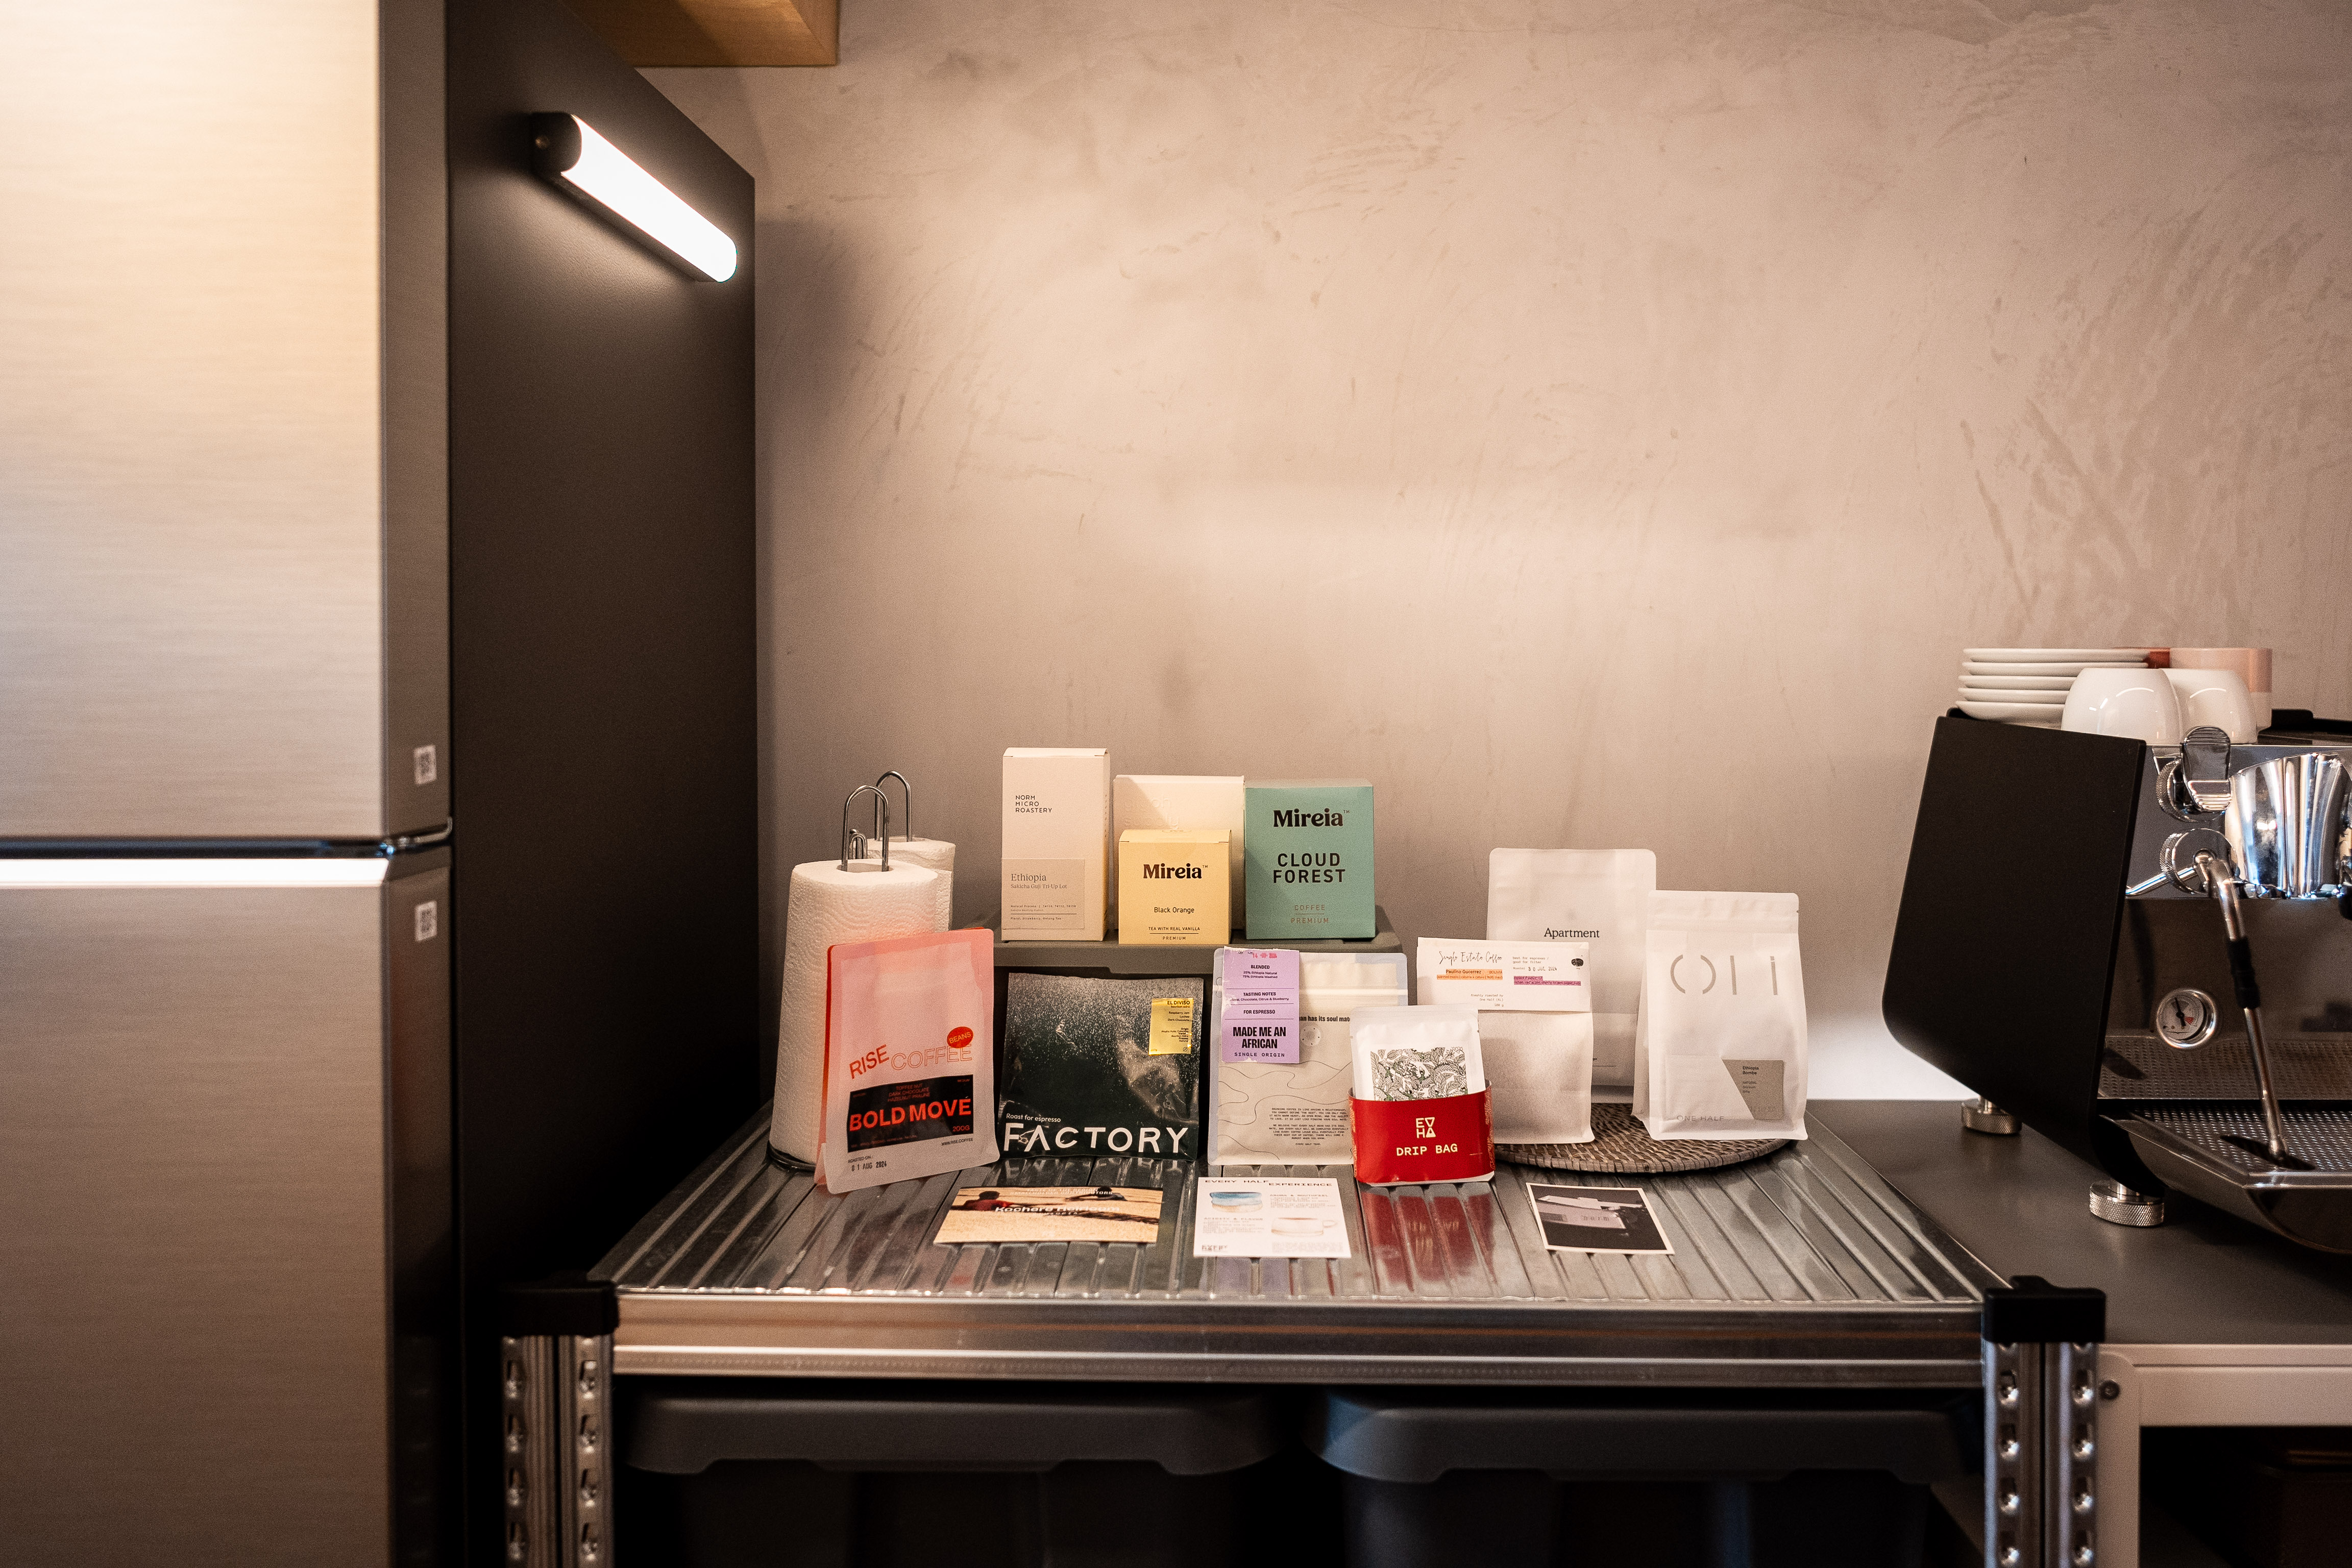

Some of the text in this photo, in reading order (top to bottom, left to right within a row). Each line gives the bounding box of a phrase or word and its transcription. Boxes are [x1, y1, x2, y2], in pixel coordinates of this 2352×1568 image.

[1273, 807, 1343, 827] Mireia
[1278, 852, 1340, 867] CLOUD
[1011, 873, 1047, 883] Ethiopia
[1143, 863, 1202, 879] Mireia
[1273, 869, 1345, 884] FOREST
[1544, 927, 1600, 939] Apartment
[949, 1032, 971, 1044] BEANS
[1233, 1026, 1286, 1037] MADE ME AN
[1242, 1039, 1278, 1049] AFRICAN
[849, 1043, 972, 1080] RISE COFFEE
[849, 1099, 971, 1132] BOLD MOVE
[1003, 1122, 1188, 1153] FACTORY
[1396, 1143, 1458, 1157] DRIP BAG
